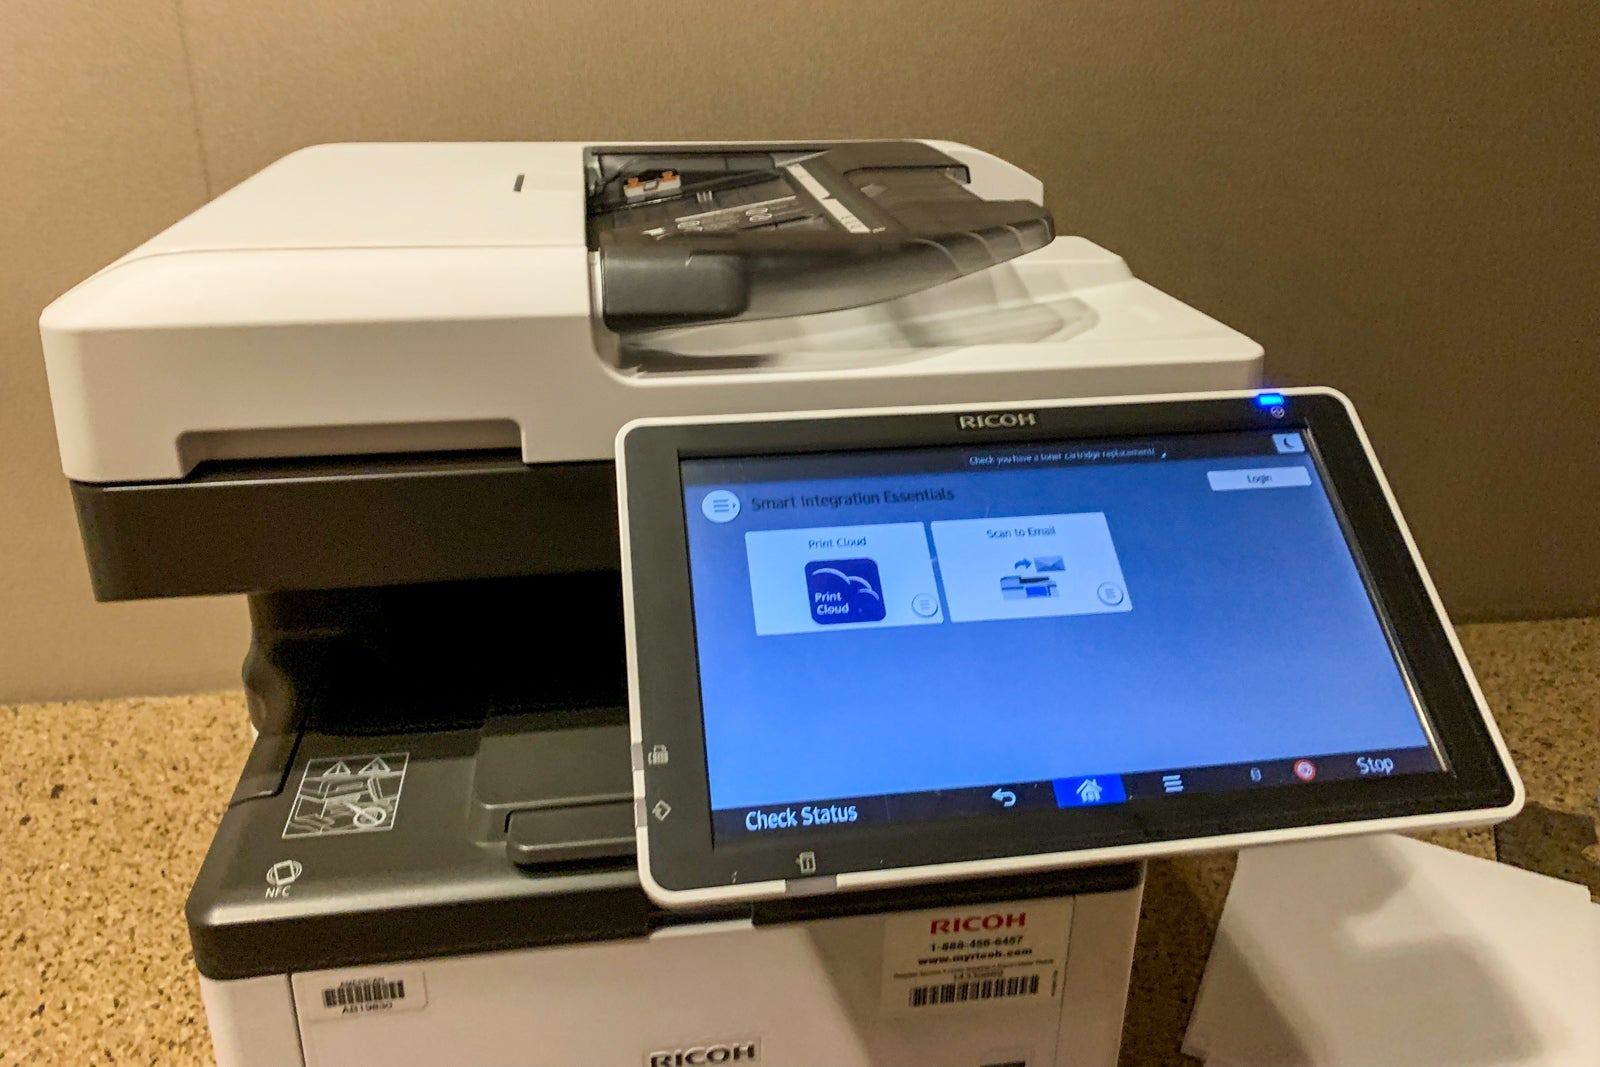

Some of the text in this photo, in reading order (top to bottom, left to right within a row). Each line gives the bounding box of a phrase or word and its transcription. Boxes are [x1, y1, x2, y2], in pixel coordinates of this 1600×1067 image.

[959, 412, 1037, 430] RICOH
[1246, 473, 1272, 485] Login
[751, 487, 955, 511] Smart Integration Essentials
[986, 526, 1057, 538] Scan to Email
[808, 536, 867, 549] Print Cloud
[815, 591, 842, 603] Print
[816, 603, 850, 616] Cloud
[1356, 756, 1394, 776] Stop
[745, 804, 858, 832] Check Status
[264, 885, 291, 899] NFC
[930, 912, 1027, 935] RICOH
[917, 947, 1033, 966] www.myricoh.com
[649, 1042, 755, 1067] RICOH
